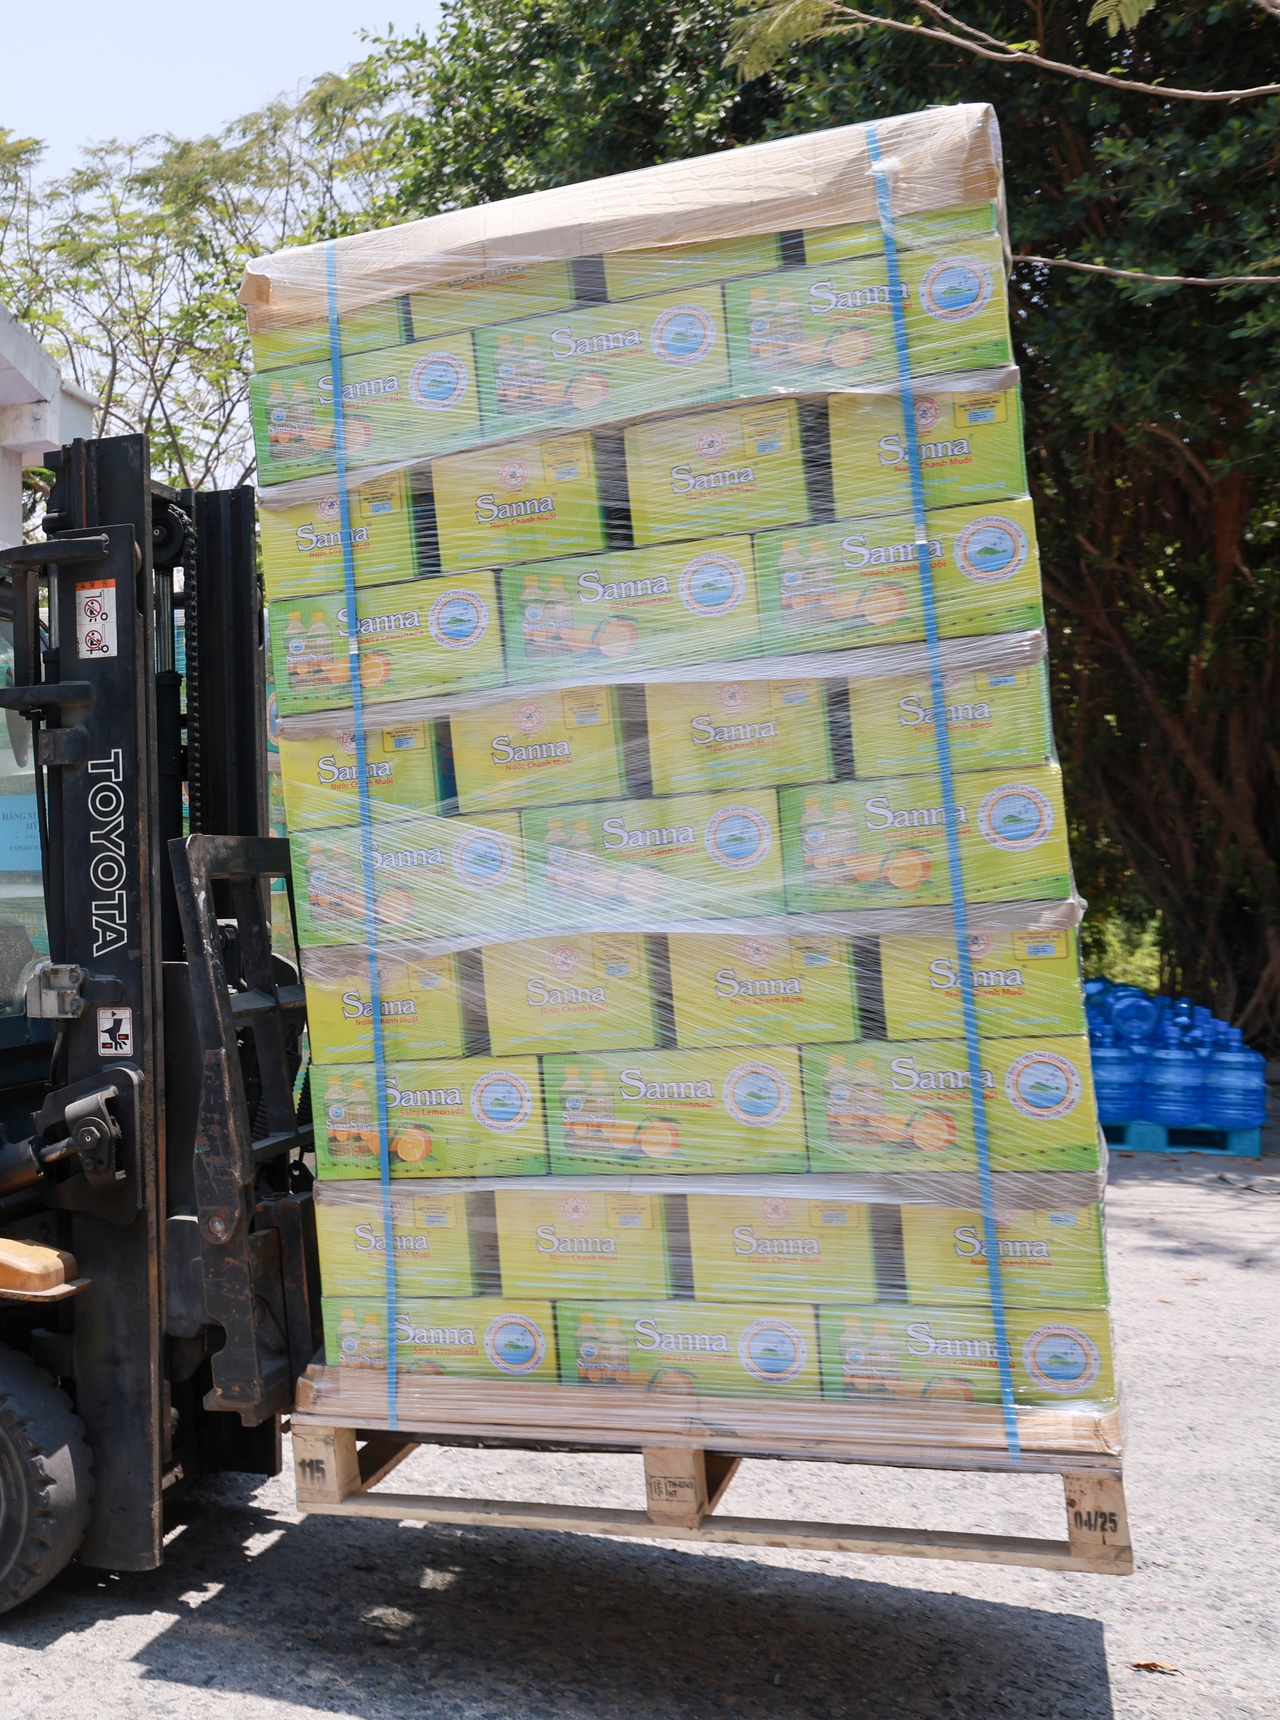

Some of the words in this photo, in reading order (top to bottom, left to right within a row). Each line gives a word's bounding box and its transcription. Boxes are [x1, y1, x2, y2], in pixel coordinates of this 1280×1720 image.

[550, 326, 643, 360] Sanna
[878, 434, 970, 466] Snna
[670, 463, 756, 495] Sanna
[475, 493, 555, 523] Sanna
[511, 515, 536, 526] Chanh
[577, 570, 671, 605] Sanna
[690, 714, 777, 746] Sanna
[490, 734, 571, 766] Sanna
[526, 759, 552, 769] Chanh
[601, 816, 696, 851] Sanna
[88, 749, 127, 957] TOYOTA
[525, 977, 607, 1008] Sanna
[714, 968, 802, 998] Sanna
[619, 1068, 715, 1102] Sanna
[399, 1108, 421, 1118] Salty
[422, 1107, 466, 1116] Lemonade
[535, 1223, 618, 1255] Sanna
[732, 1224, 822, 1256] Sanna
[394, 1313, 477, 1347] Sanna
[633, 1317, 730, 1353] Sanna
[413, 1346, 434, 1355] Salty
[435, 1347, 480, 1356] Lemonade
[298, 1459, 326, 1486] 115
[1074, 1510, 1117, 1533] 04/25
